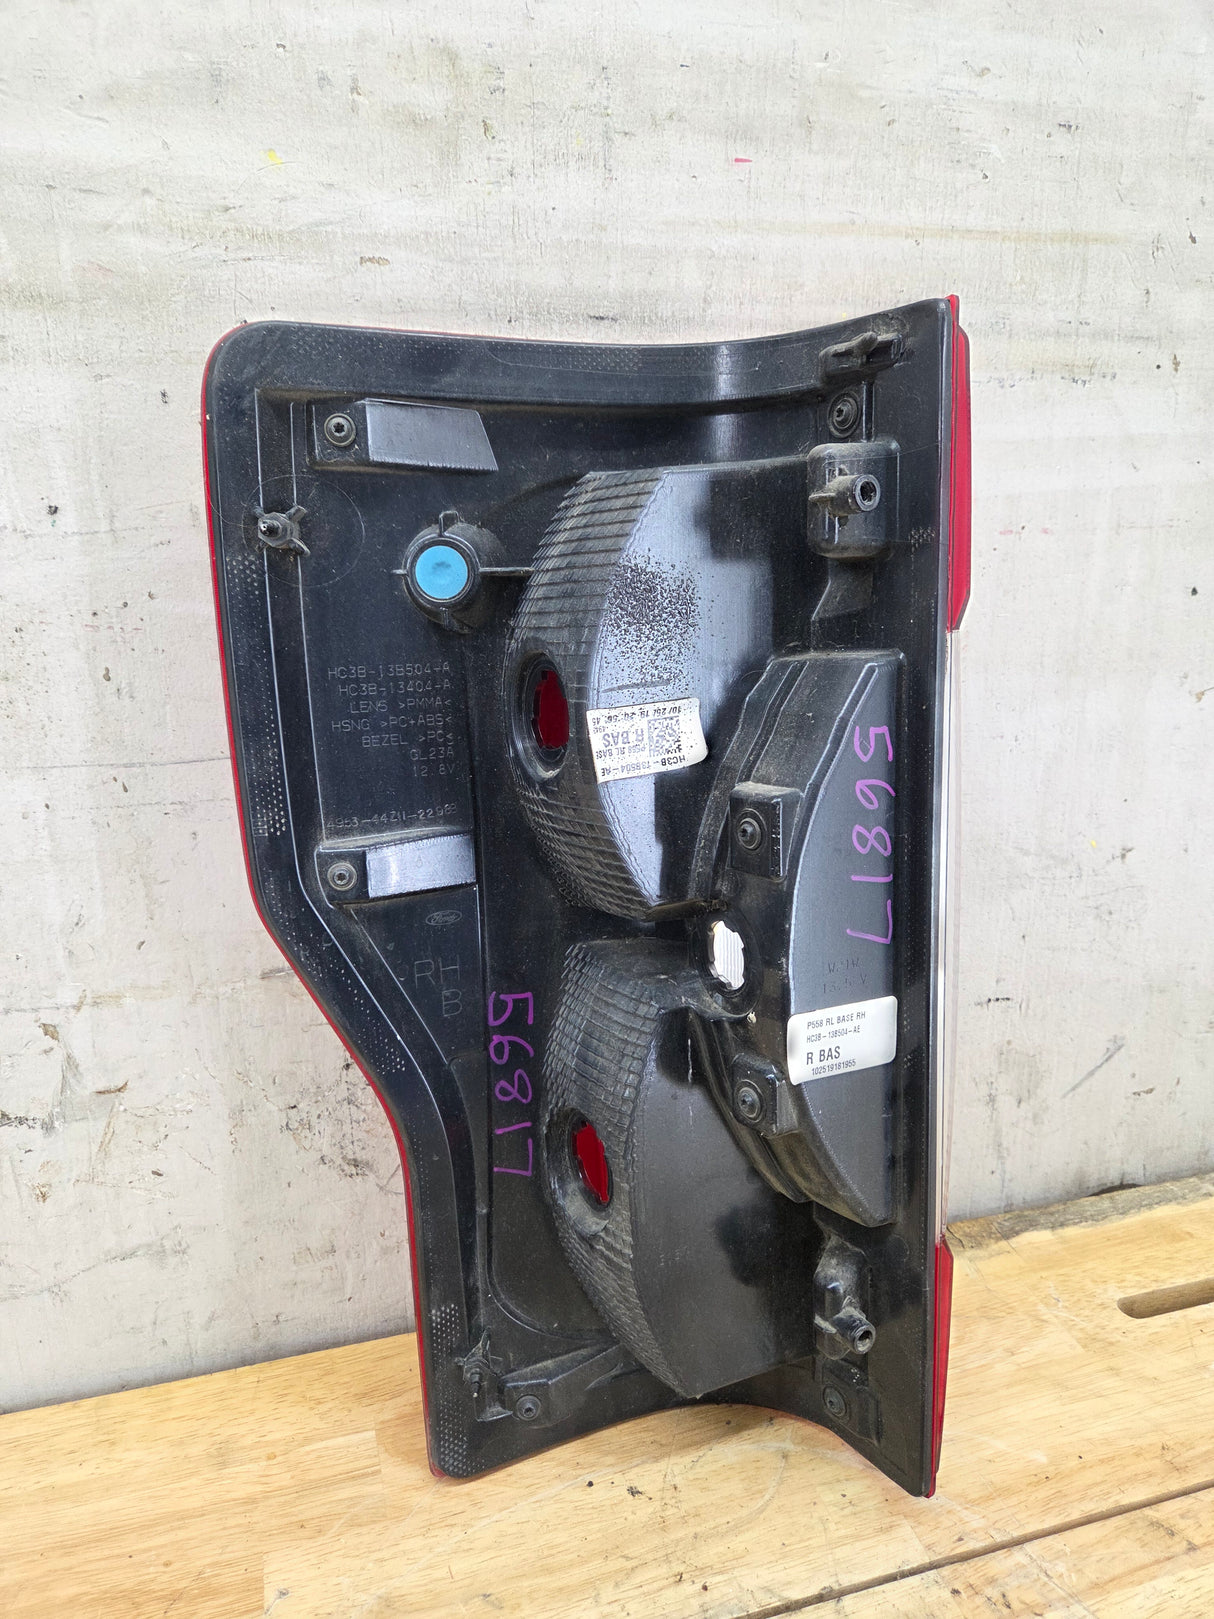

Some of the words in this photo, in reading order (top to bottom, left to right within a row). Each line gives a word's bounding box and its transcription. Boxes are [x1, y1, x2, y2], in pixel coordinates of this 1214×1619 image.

[327, 661, 450, 680] HC3B-13B504-A
[339, 679, 451, 696] HC3B-13404-A
[350, 700, 388, 713] LENS
[331, 719, 370, 732] HSNG
[362, 734, 408, 747] BEZEL
[602, 730, 630, 748] BAS
[846, 725, 896, 945] 56817
[414, 955, 460, 988] RH
[442, 989, 462, 1017] B
[807, 1019, 823, 1029] P558
[826, 1018, 834, 1026] RL
[837, 1013, 854, 1024] BASE
[856, 1011, 866, 1020] RH
[806, 1052, 813, 1065] R
[819, 1046, 841, 1062] BAS
[811, 1059, 856, 1076] 102519181955
[487, 991, 534, 1177] 56817
